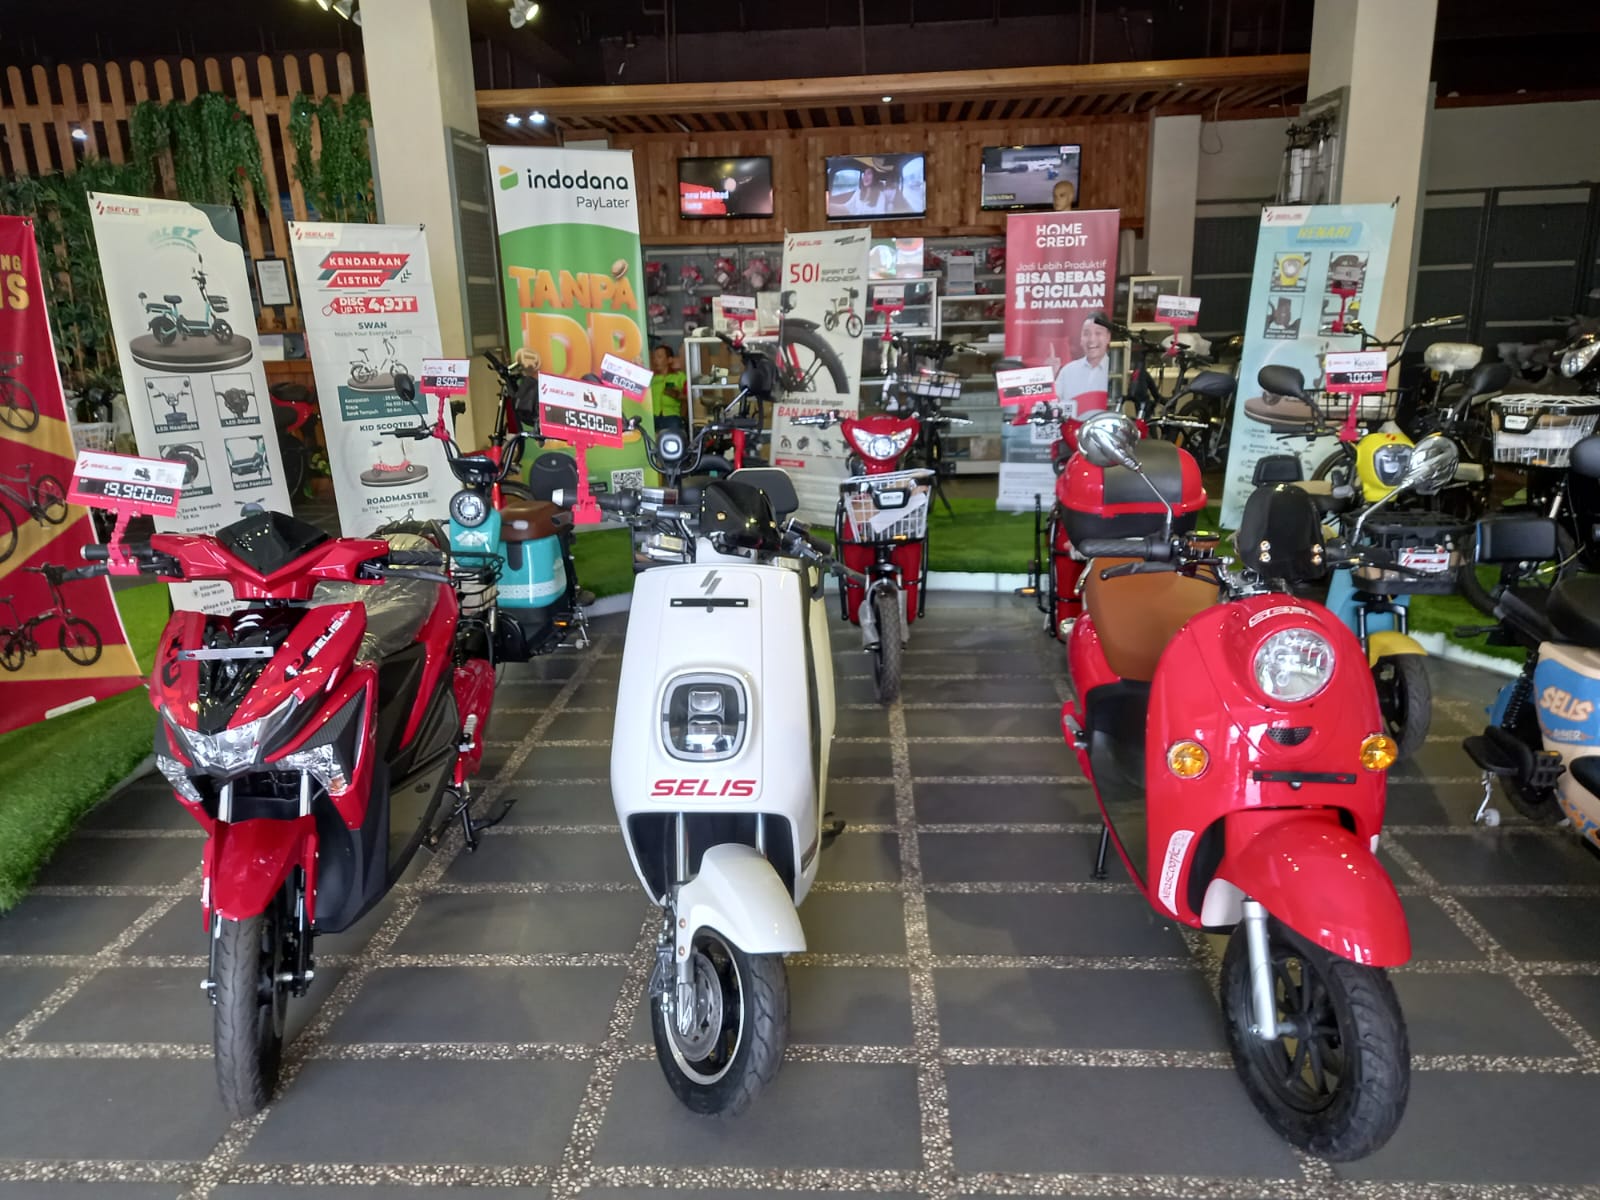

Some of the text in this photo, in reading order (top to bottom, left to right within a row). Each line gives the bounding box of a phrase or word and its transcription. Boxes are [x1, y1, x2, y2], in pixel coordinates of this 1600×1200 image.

[527, 168, 629, 190] indodana
[576, 196, 630, 211] PayLater
[1036, 223, 1083, 235] HOME
[1036, 235, 1088, 248] CREDIT
[328, 256, 402, 266] KENDARAAN
[1016, 259, 1107, 271] Jadi Lebih Produktif
[336, 275, 381, 285] LISTRIK
[790, 263, 820, 284] 501
[821, 275, 861, 283] INDONESIA
[1015, 270, 1106, 284] BISA BEBAS
[0, 273, 29, 310] S
[508, 265, 639, 311] TANPA
[1031, 283, 1105, 298] CICILAN
[339, 297, 365, 306] DISC
[368, 297, 414, 313] 4,9JT
[1030, 299, 1104, 309] DI MANA AJA
[358, 321, 387, 330] SWAN
[521, 312, 643, 448] DP
[777, 406, 799, 416] BAN
[376, 421, 414, 430] SCOOTER
[366, 491, 429, 505] ROADMASTER
[307, 619, 343, 659] SELIS
[1540, 686, 1595, 722] SELIS
[650, 779, 757, 797] SELIS
